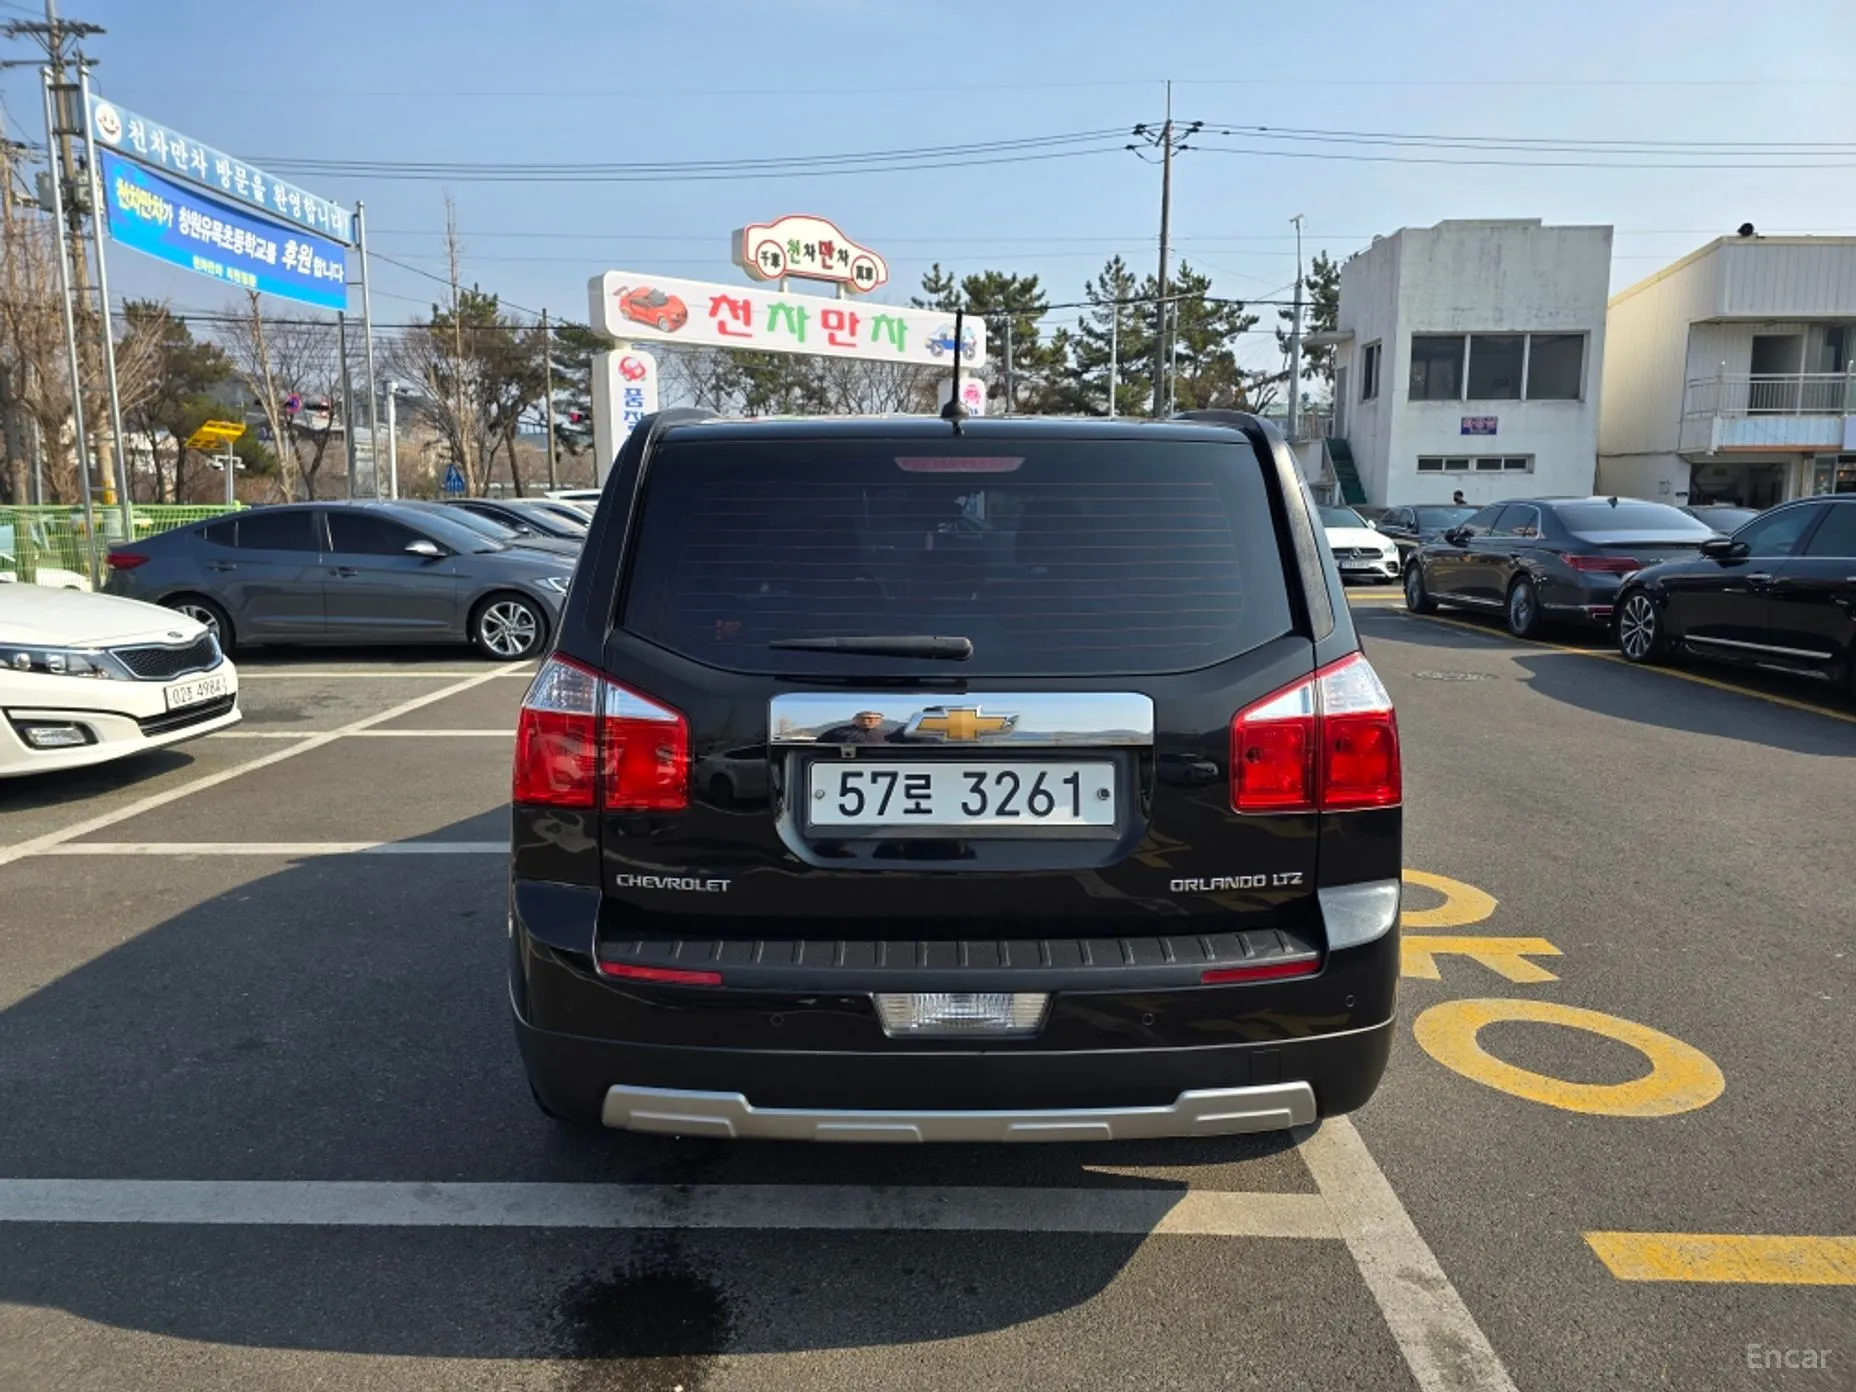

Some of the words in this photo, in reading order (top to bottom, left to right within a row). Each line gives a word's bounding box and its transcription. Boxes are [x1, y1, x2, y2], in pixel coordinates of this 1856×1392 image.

[128, 119, 207, 178] 천차만차
[215, 158, 266, 203] 방문을
[273, 183, 350, 238] 환영합니다
[786, 238, 850, 270] 천차만차
[708, 293, 909, 353] 천차만차
[837, 770, 934, 817] 57로
[960, 770, 1082, 817] 3261
[616, 873, 732, 892] CHEVROLET
[1169, 874, 1267, 892] ORLANDO
[1272, 871, 1304, 886] LTZ
